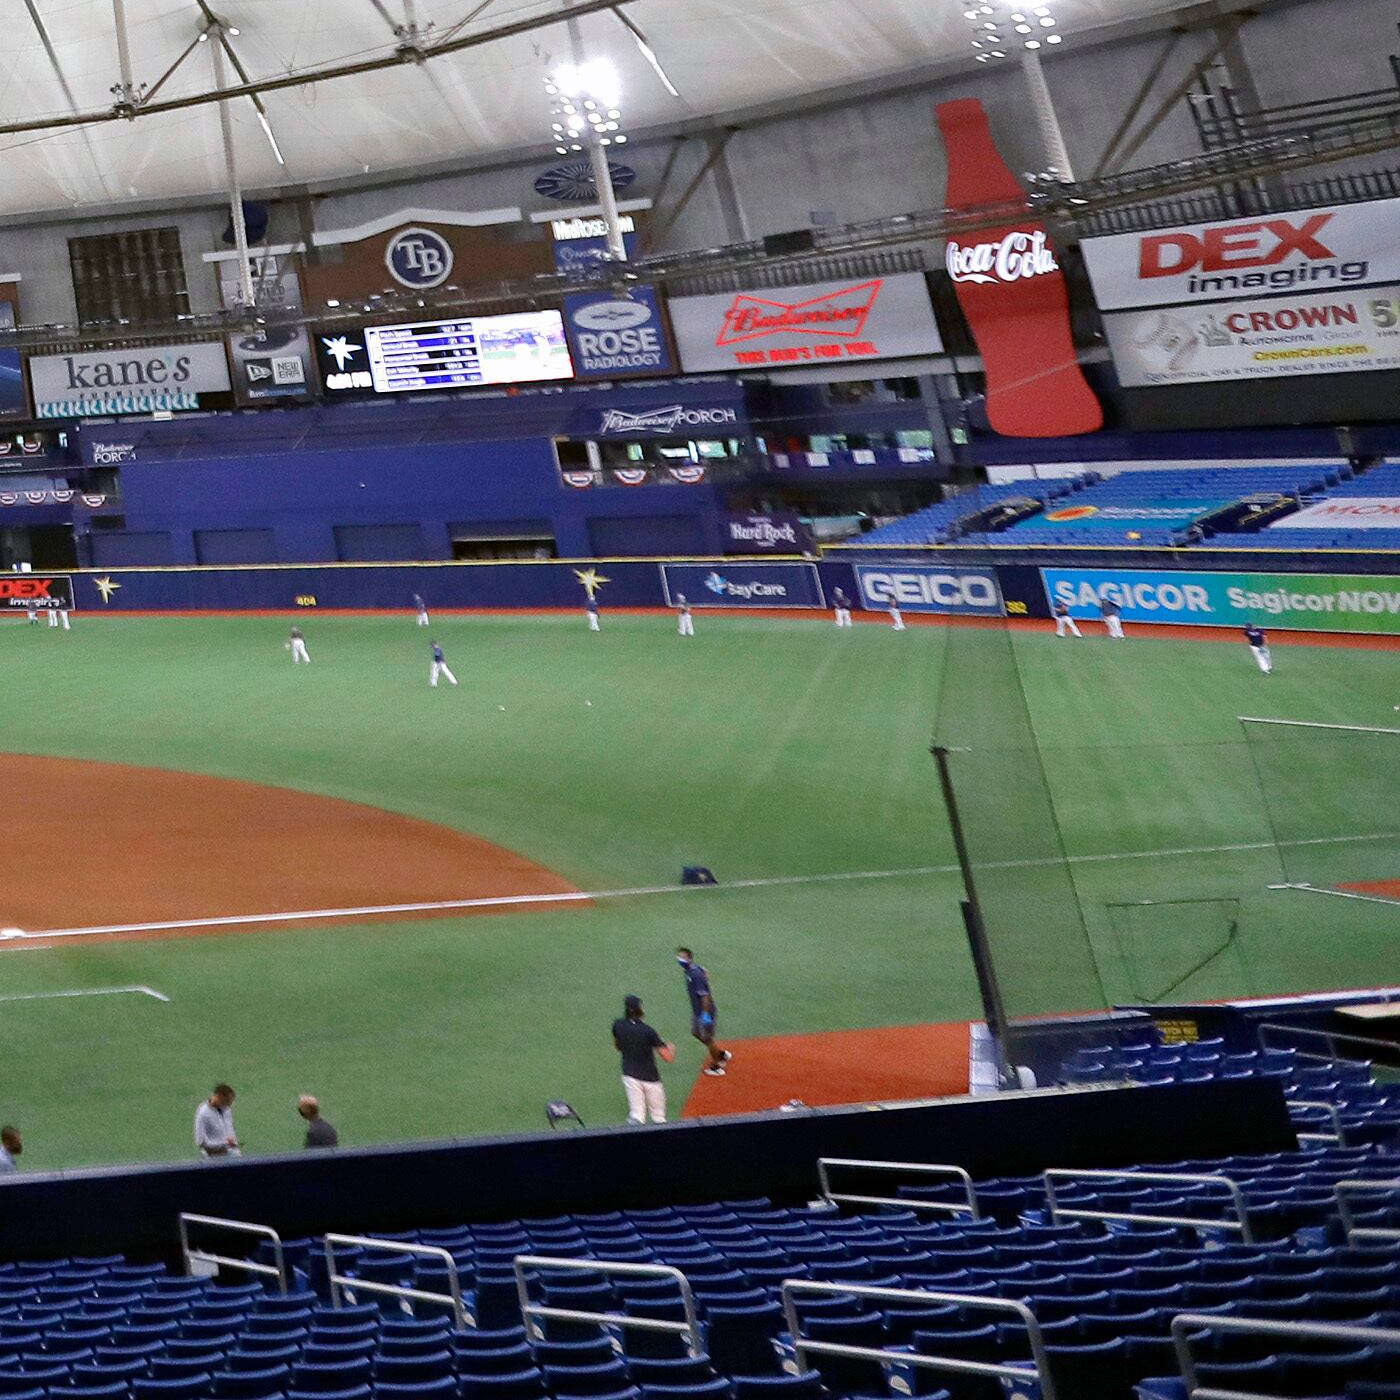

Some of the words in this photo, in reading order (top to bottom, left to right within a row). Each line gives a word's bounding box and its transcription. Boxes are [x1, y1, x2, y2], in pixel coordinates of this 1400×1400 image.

[397, 239, 445, 277] TB
[1138, 212, 1338, 280] DEX
[1185, 260, 1369, 294] imaging
[1226, 303, 1359, 335] CROWN
[577, 328, 661, 357] ROSE
[63, 355, 192, 390] kane's
[277, 361, 299, 371] NEW
[279, 369, 301, 379] ERA
[583, 352, 663, 370] RADIOLOGY
[678, 407, 736, 425] PORCH
[764, 523, 797, 543] Rock
[860, 571, 998, 606] GEICO
[1055, 580, 1213, 613] SAGICOR
